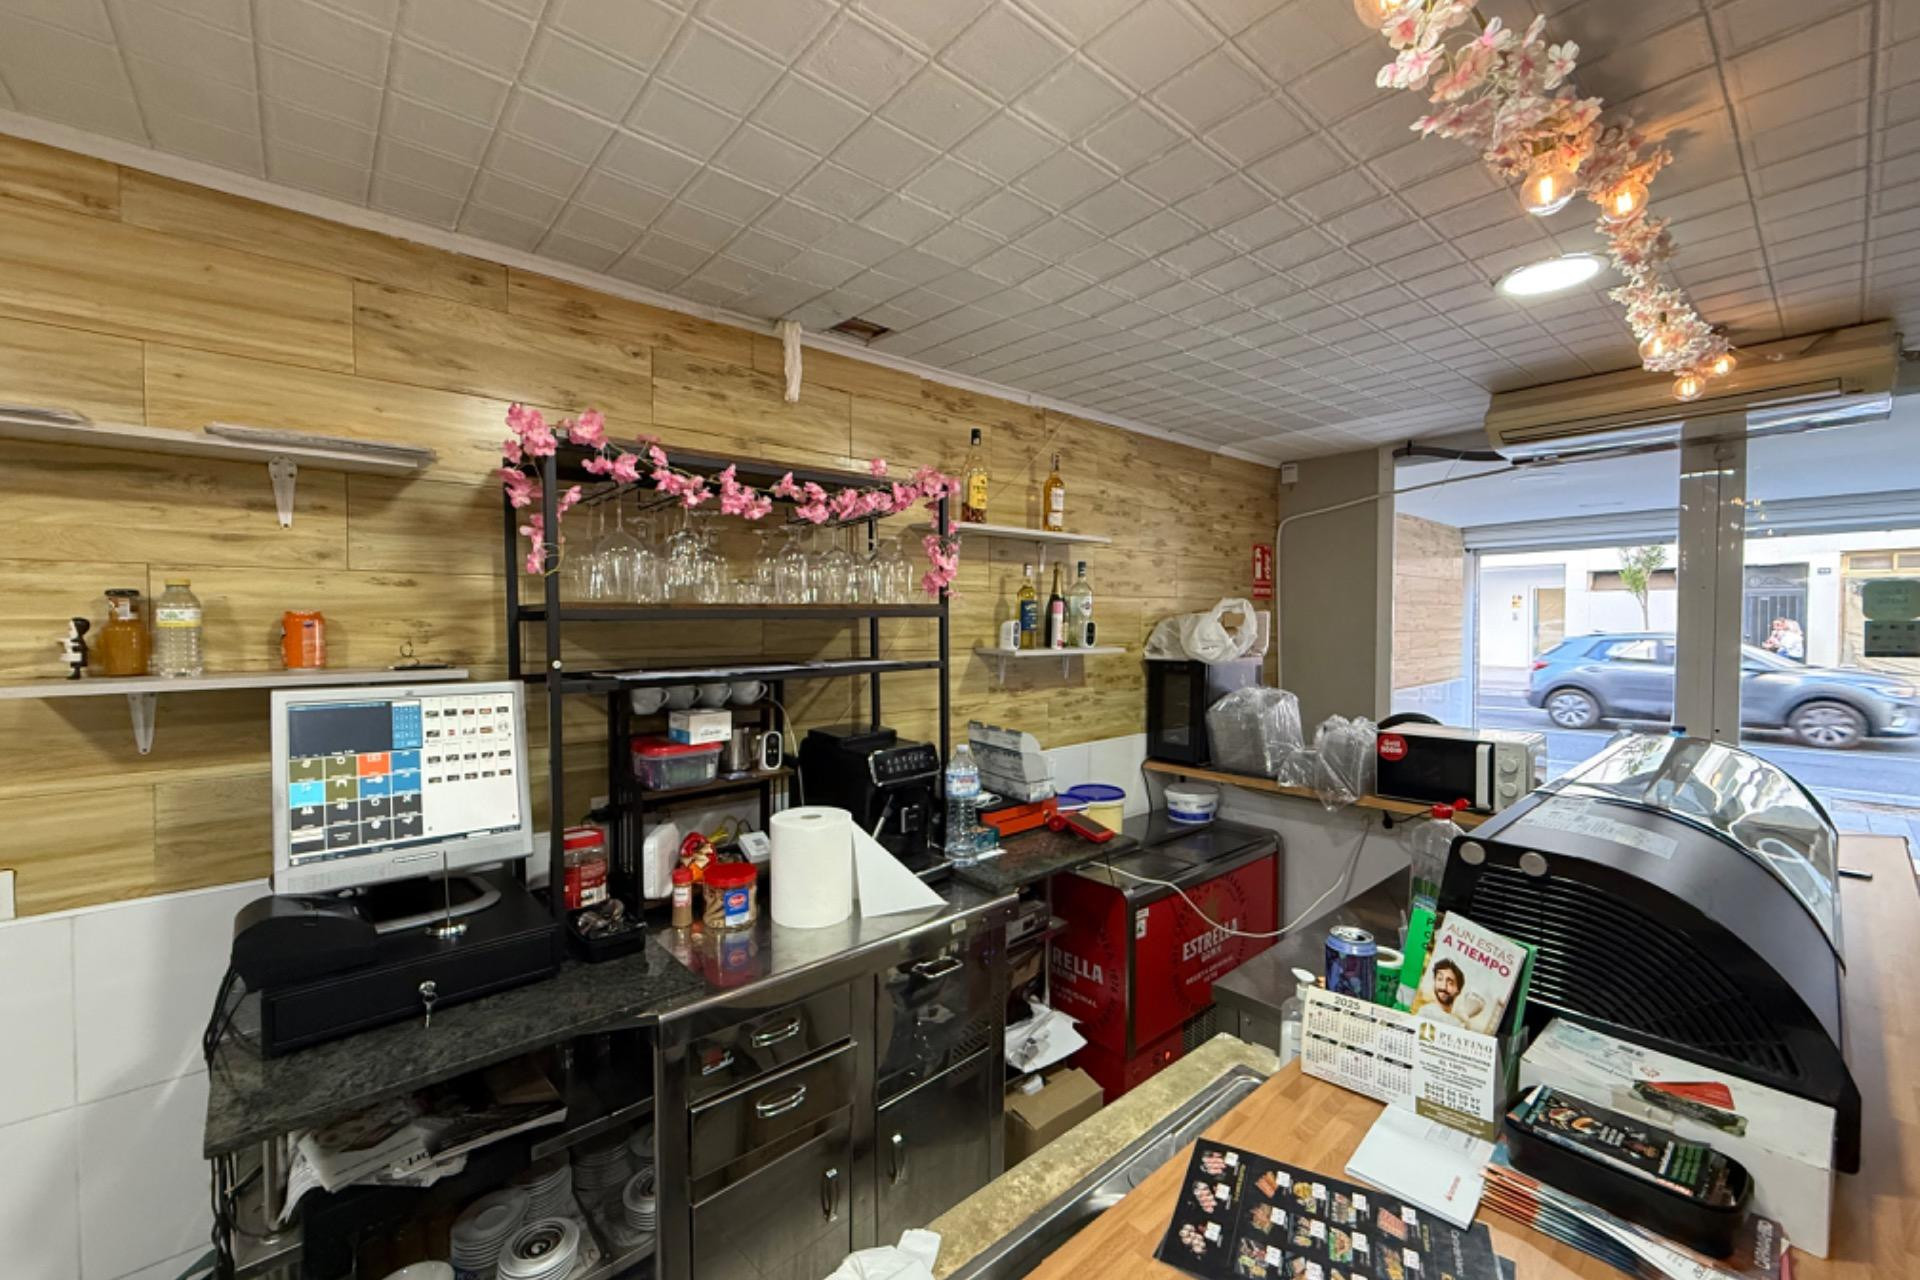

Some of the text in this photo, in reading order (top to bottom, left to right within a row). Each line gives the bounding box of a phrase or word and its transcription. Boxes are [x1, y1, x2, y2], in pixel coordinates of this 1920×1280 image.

[1053, 946, 1104, 985] RELLA
[1442, 934, 1511, 978] A TIEMPO
[1334, 996, 1361, 1010] 2025
